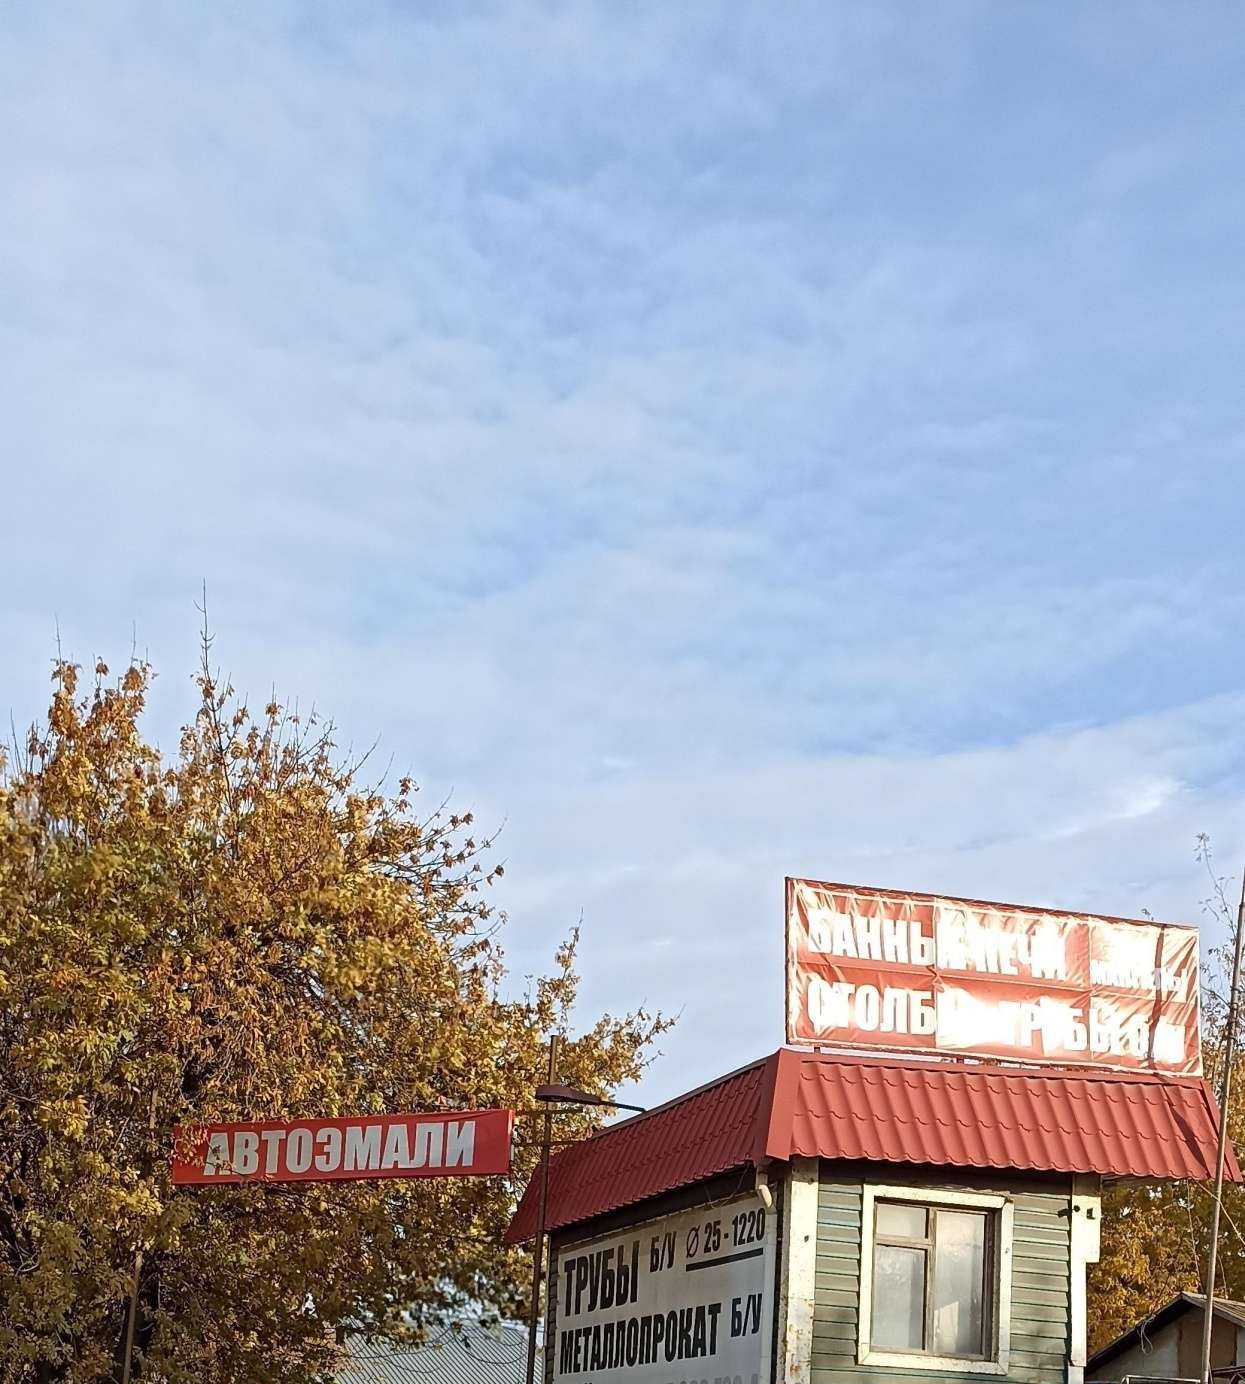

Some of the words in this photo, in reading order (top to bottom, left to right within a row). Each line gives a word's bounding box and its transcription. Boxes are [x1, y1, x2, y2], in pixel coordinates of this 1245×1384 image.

[808, 907, 968, 971] БАННЫ
[807, 978, 950, 1040] СТОЛБ
[203, 1120, 476, 1176] АВТОЭМАЛИ
[564, 1240, 641, 1317] ТРУБЫ
[650, 1231, 677, 1272] Б/У
[559, 1302, 722, 1375] МЕТАЛЛОПРОКАТ
[730, 1293, 763, 1338] Б/У
